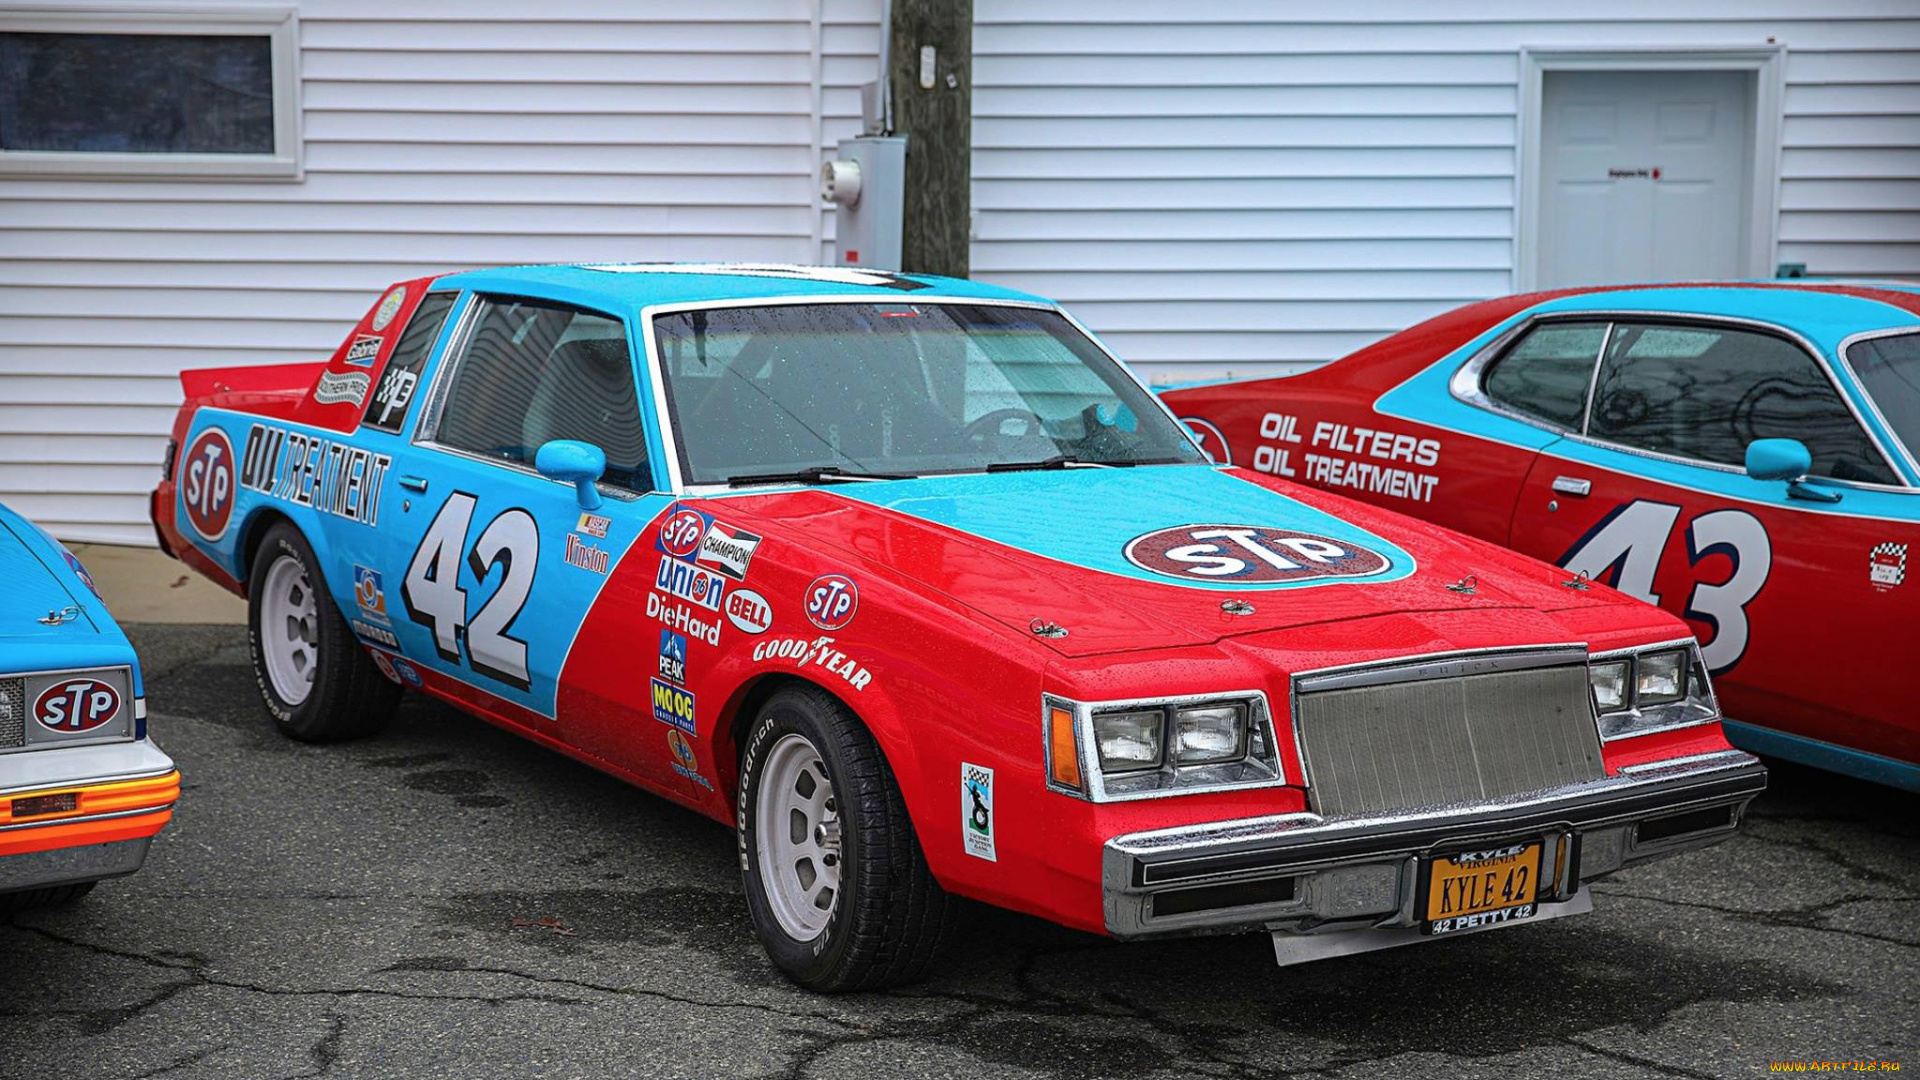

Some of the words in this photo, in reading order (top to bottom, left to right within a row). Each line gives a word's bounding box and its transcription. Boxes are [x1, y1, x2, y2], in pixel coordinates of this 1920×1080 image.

[1260, 412, 1302, 443] OIL
[1312, 421, 1440, 466] FILTERS
[187, 443, 230, 519] STP
[240, 423, 286, 494] OIL
[273, 431, 391, 528] TREATMENT
[1253, 446, 1296, 477] OIL
[1304, 453, 1439, 503] TREATMENT
[565, 533, 609, 575] Winston
[664, 514, 700, 549] STP
[703, 536, 751, 565] CHAMPION
[1165, 529, 1347, 577] STP
[400, 489, 540, 693] 42
[694, 579, 706, 595] 76
[809, 580, 851, 622] STP
[1556, 499, 1772, 678] 43
[646, 592, 722, 646] DieHard
[728, 593, 767, 629] BELL
[659, 655, 685, 680] PEAK
[753, 636, 873, 692] GOODYEAR
[1418, 660, 1500, 677] BUICK
[43, 682, 114, 728] STP
[653, 683, 694, 722] MOOG
[738, 717, 775, 871] BFGoodrich
[1460, 844, 1522, 863] KYLE
[1440, 871, 1498, 915] KYLE
[1501, 865, 1529, 902] 42
[1433, 921, 1452, 934] 42
[1455, 910, 1509, 930] PETTY
[1515, 905, 1531, 918] 42
